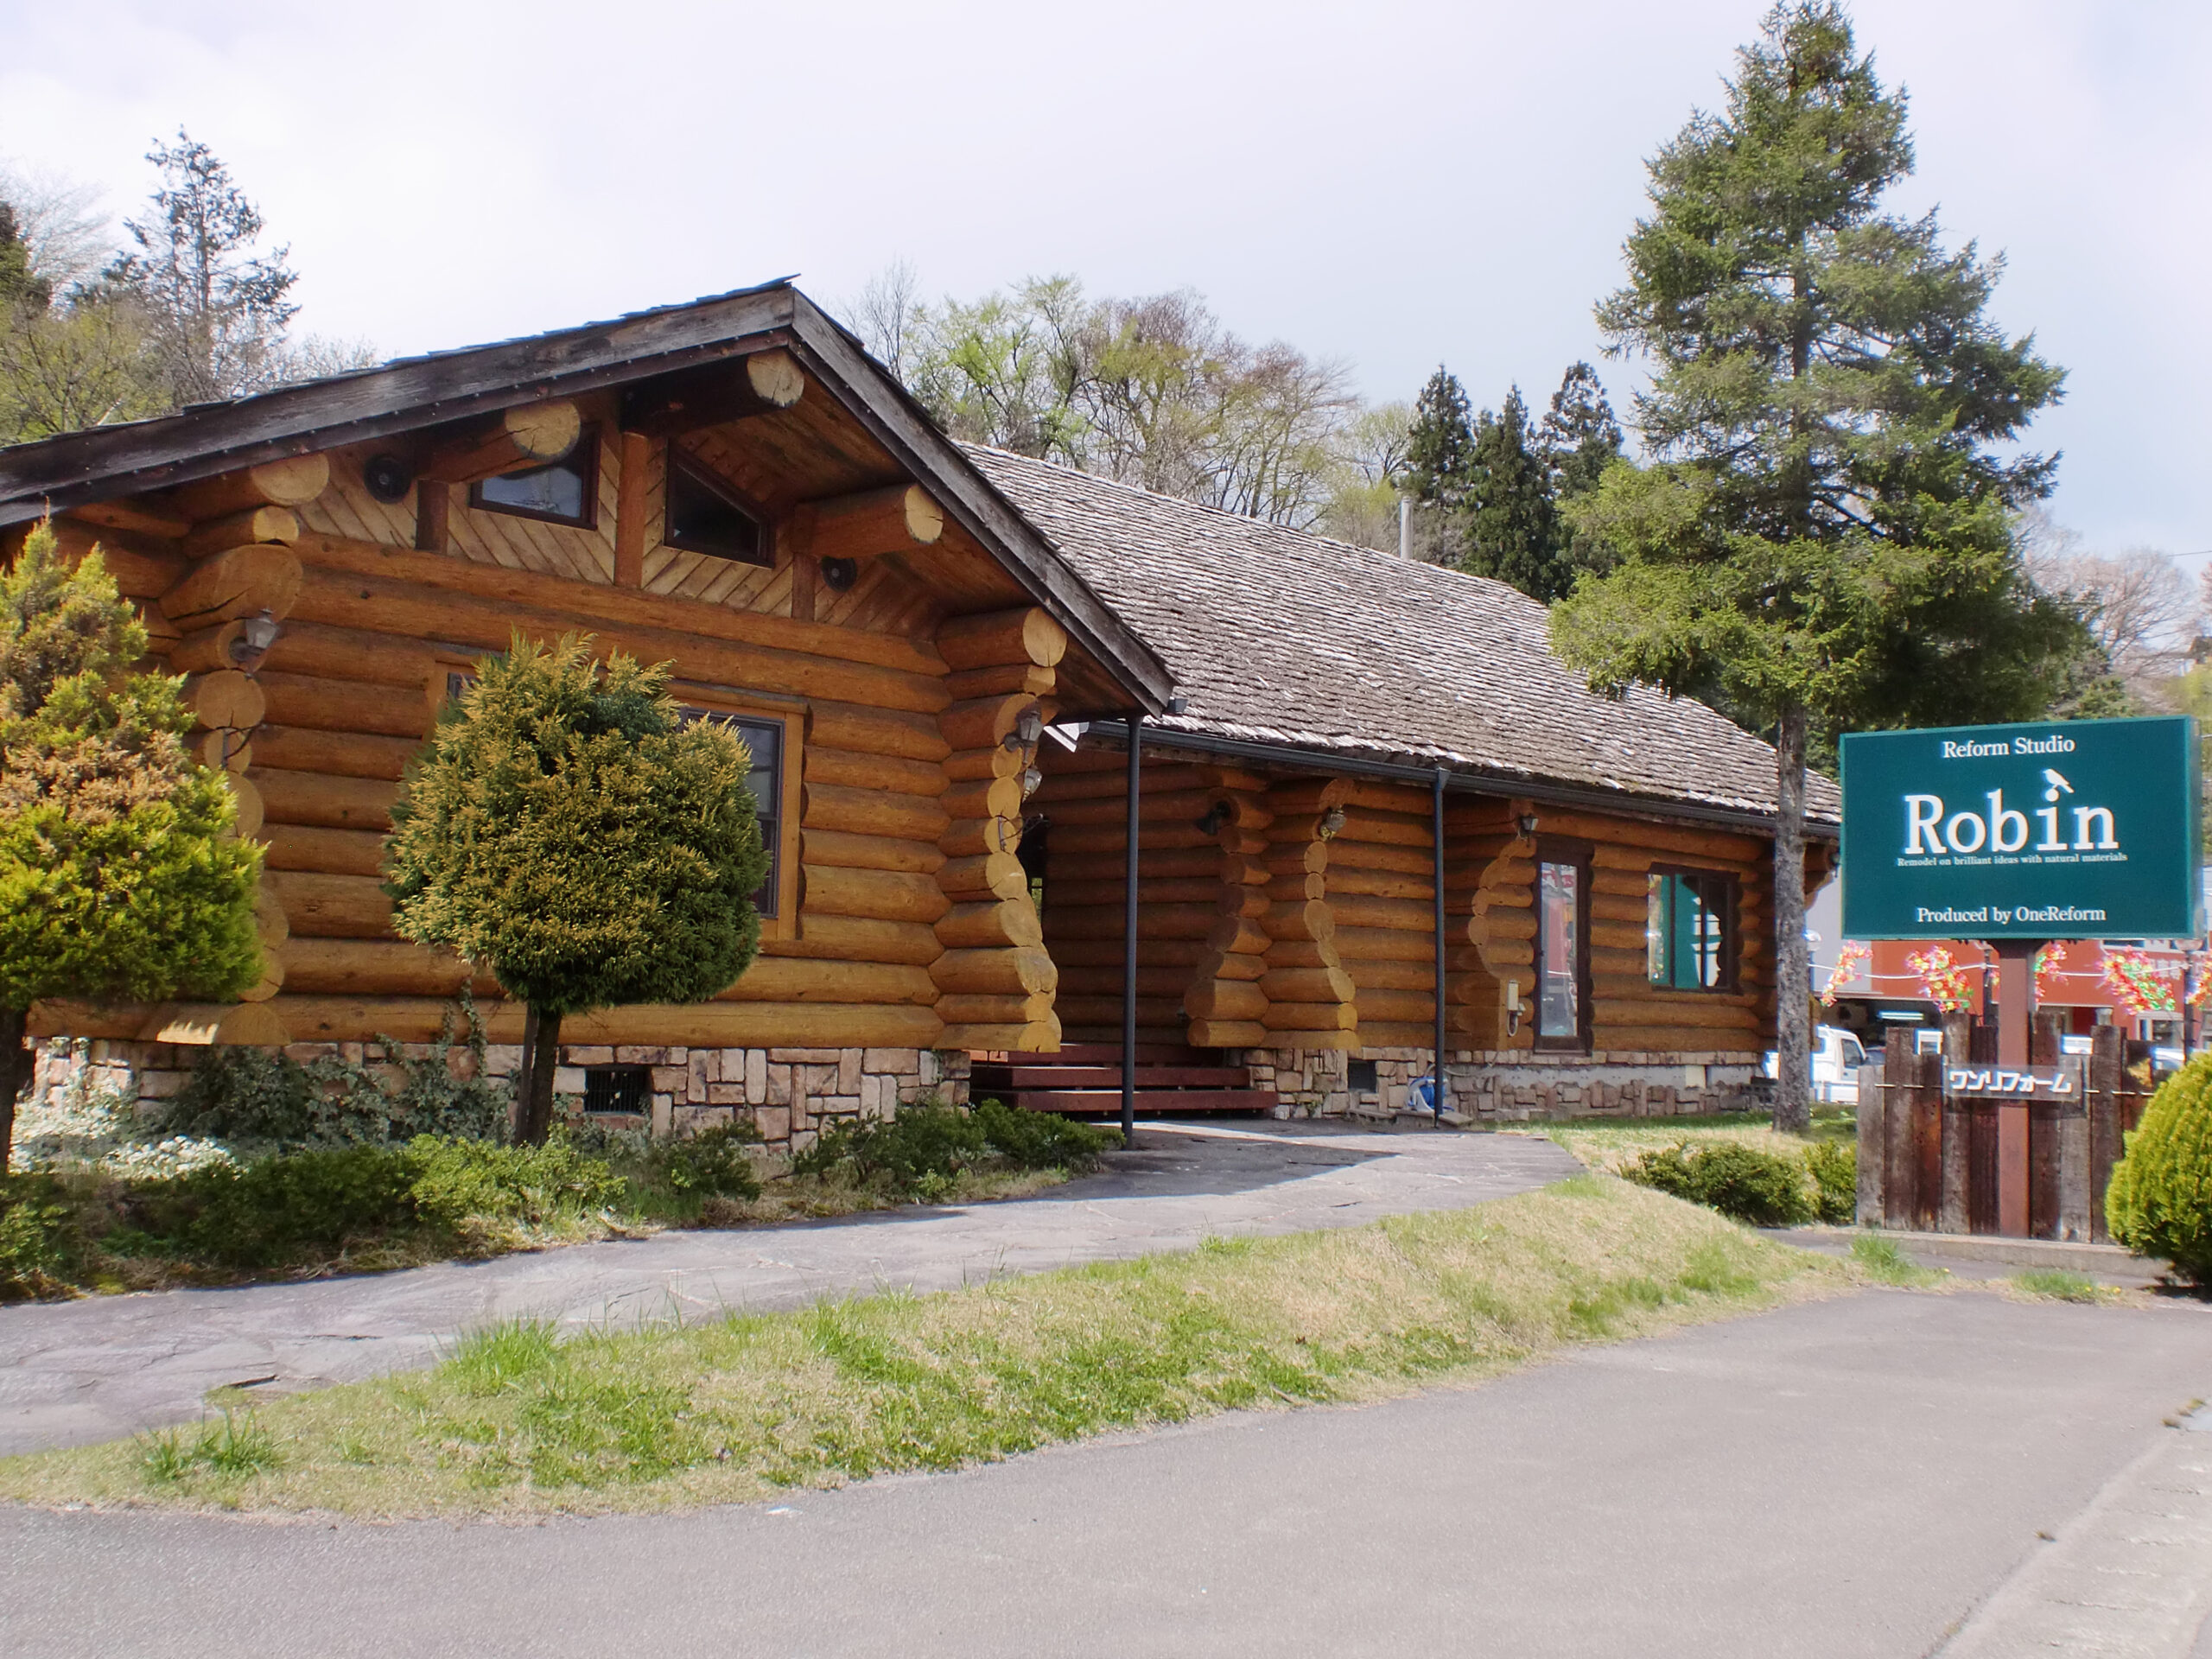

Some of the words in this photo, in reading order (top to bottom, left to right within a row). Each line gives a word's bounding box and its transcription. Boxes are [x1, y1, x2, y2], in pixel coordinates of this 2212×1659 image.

[1942, 740, 2010, 759] Reform
[2014, 734, 2076, 755] Studio
[1904, 787, 2120, 855] Robin
[1897, 857, 1937, 867] Remodel
[1954, 855, 1992, 865] brilliant
[1994, 855, 2019, 864] ideas
[2021, 854, 2043, 863] with
[2044, 853, 2080, 863] natural
[2082, 852, 2128, 861] materials
[1916, 906, 1988, 923] Produced
[1993, 906, 2012, 925] by
[2016, 906, 2107, 922] OneReform
[1949, 1071, 2073, 1094] ワンリフォーム
